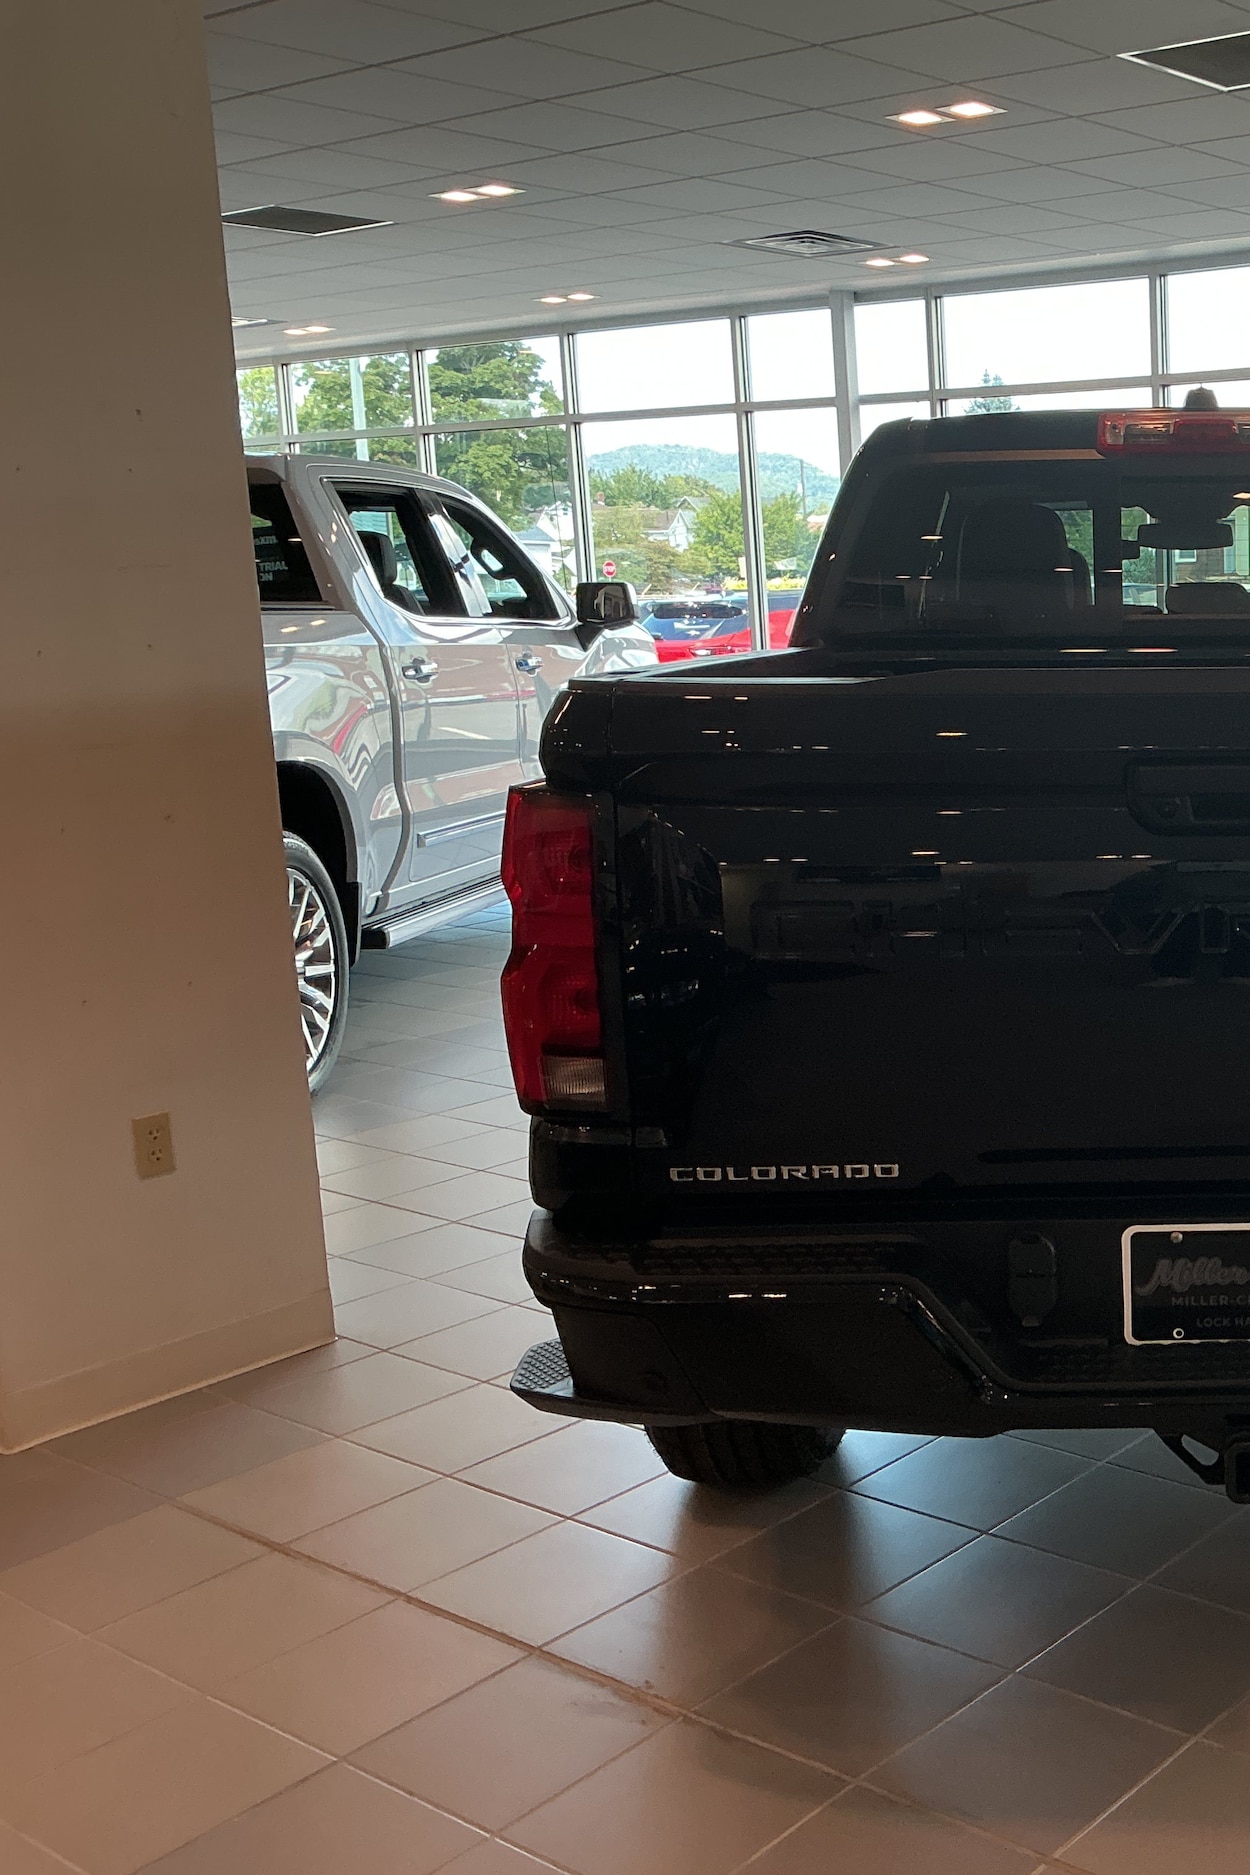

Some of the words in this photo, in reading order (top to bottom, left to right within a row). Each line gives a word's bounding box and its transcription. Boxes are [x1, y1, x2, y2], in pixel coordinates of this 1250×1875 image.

[669, 1163, 900, 1182] COLORADO
[1134, 1257, 1248, 1295] Miller
[1196, 1317, 1229, 1328] LOCK
